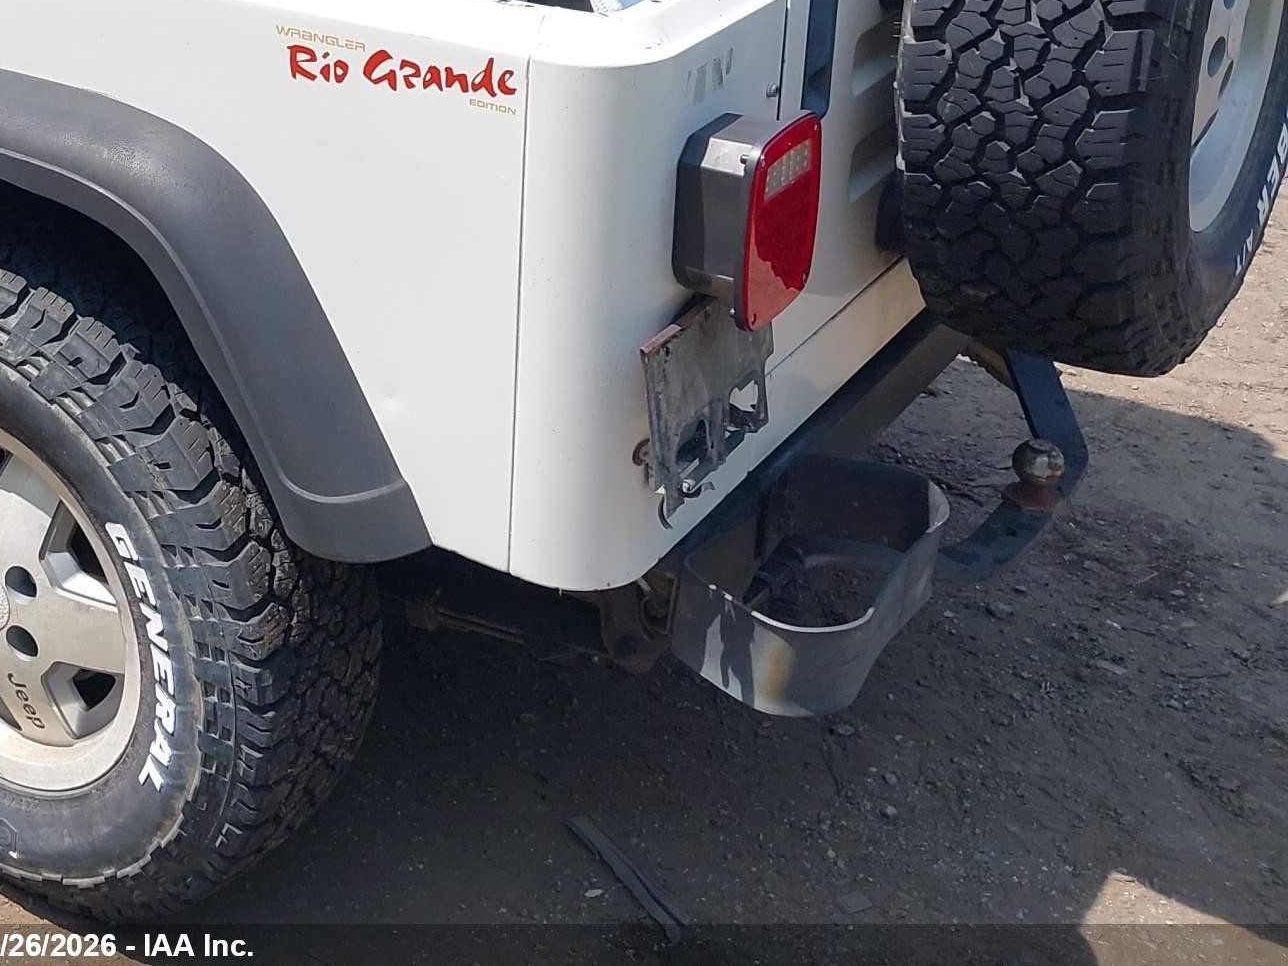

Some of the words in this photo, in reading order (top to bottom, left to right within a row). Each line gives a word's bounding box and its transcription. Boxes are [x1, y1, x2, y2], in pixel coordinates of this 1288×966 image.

[276, 25, 366, 52] WRANGLER
[362, 49, 518, 98] Grande
[469, 97, 517, 116] EDITION
[105, 522, 176, 792] GENERAL
[8, 672, 46, 729] Jeep
